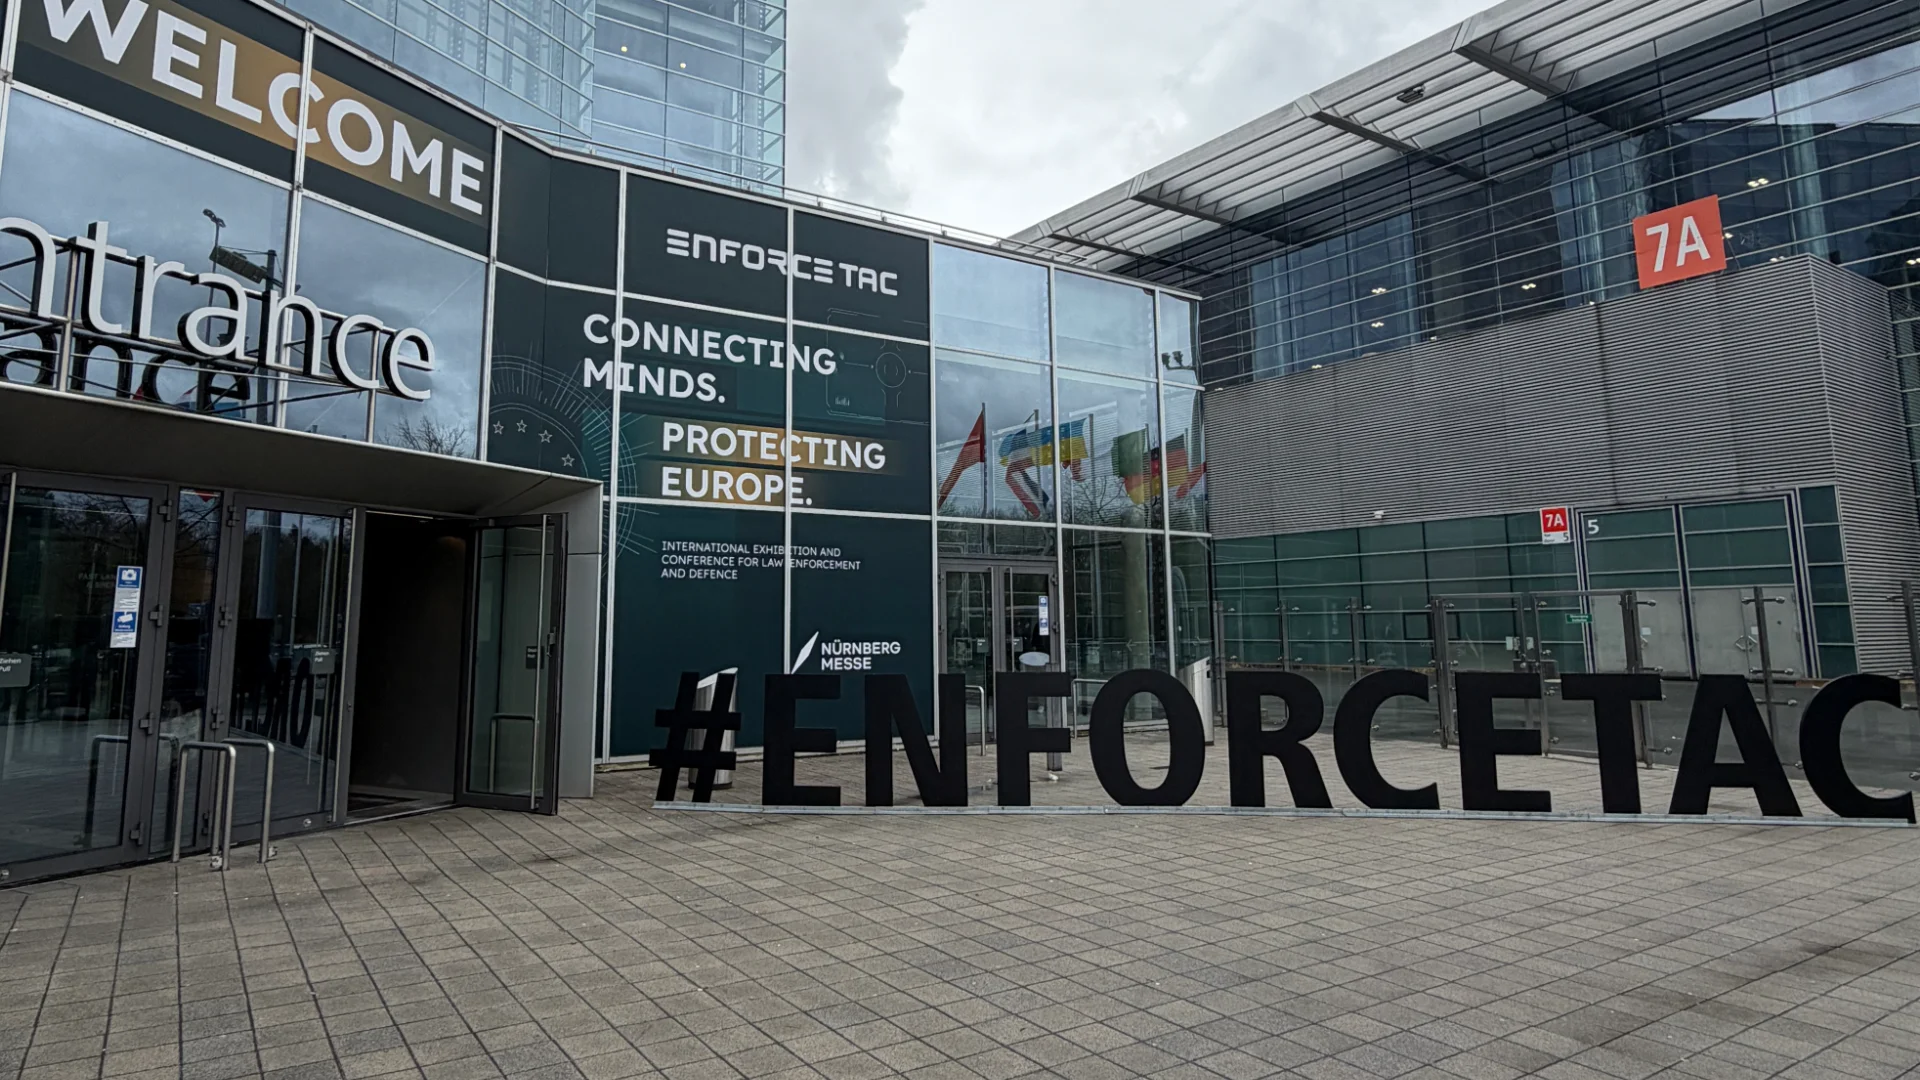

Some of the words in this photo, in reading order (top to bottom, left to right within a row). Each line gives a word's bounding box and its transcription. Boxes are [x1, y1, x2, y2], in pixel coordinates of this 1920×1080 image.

[43, 0, 484, 215] WELCOME
[1645, 216, 1711, 272] 7A
[838, 262, 898, 296] TAC
[583, 313, 836, 375] CONNECTING
[583, 357, 726, 403] MINDS.
[663, 421, 886, 470] PROTECTING
[662, 466, 813, 506] EUROPE.
[1545, 513, 1565, 528] 7A
[1588, 518, 1600, 535] 5
[661, 540, 750, 554] INTERNATIONAL
[820, 547, 841, 557] AND
[661, 554, 735, 567] CONFERENCE
[738, 557, 759, 568] FOR
[761, 558, 784, 568] LAW
[789, 559, 861, 571] ENFORCEMENT
[661, 568, 686, 579] AND
[689, 569, 738, 580] DEFENCE
[821, 639, 901, 656] NÜRNBERG
[821, 657, 872, 671] MESSE
[649, 669, 1917, 824] #ENFORCETAC
